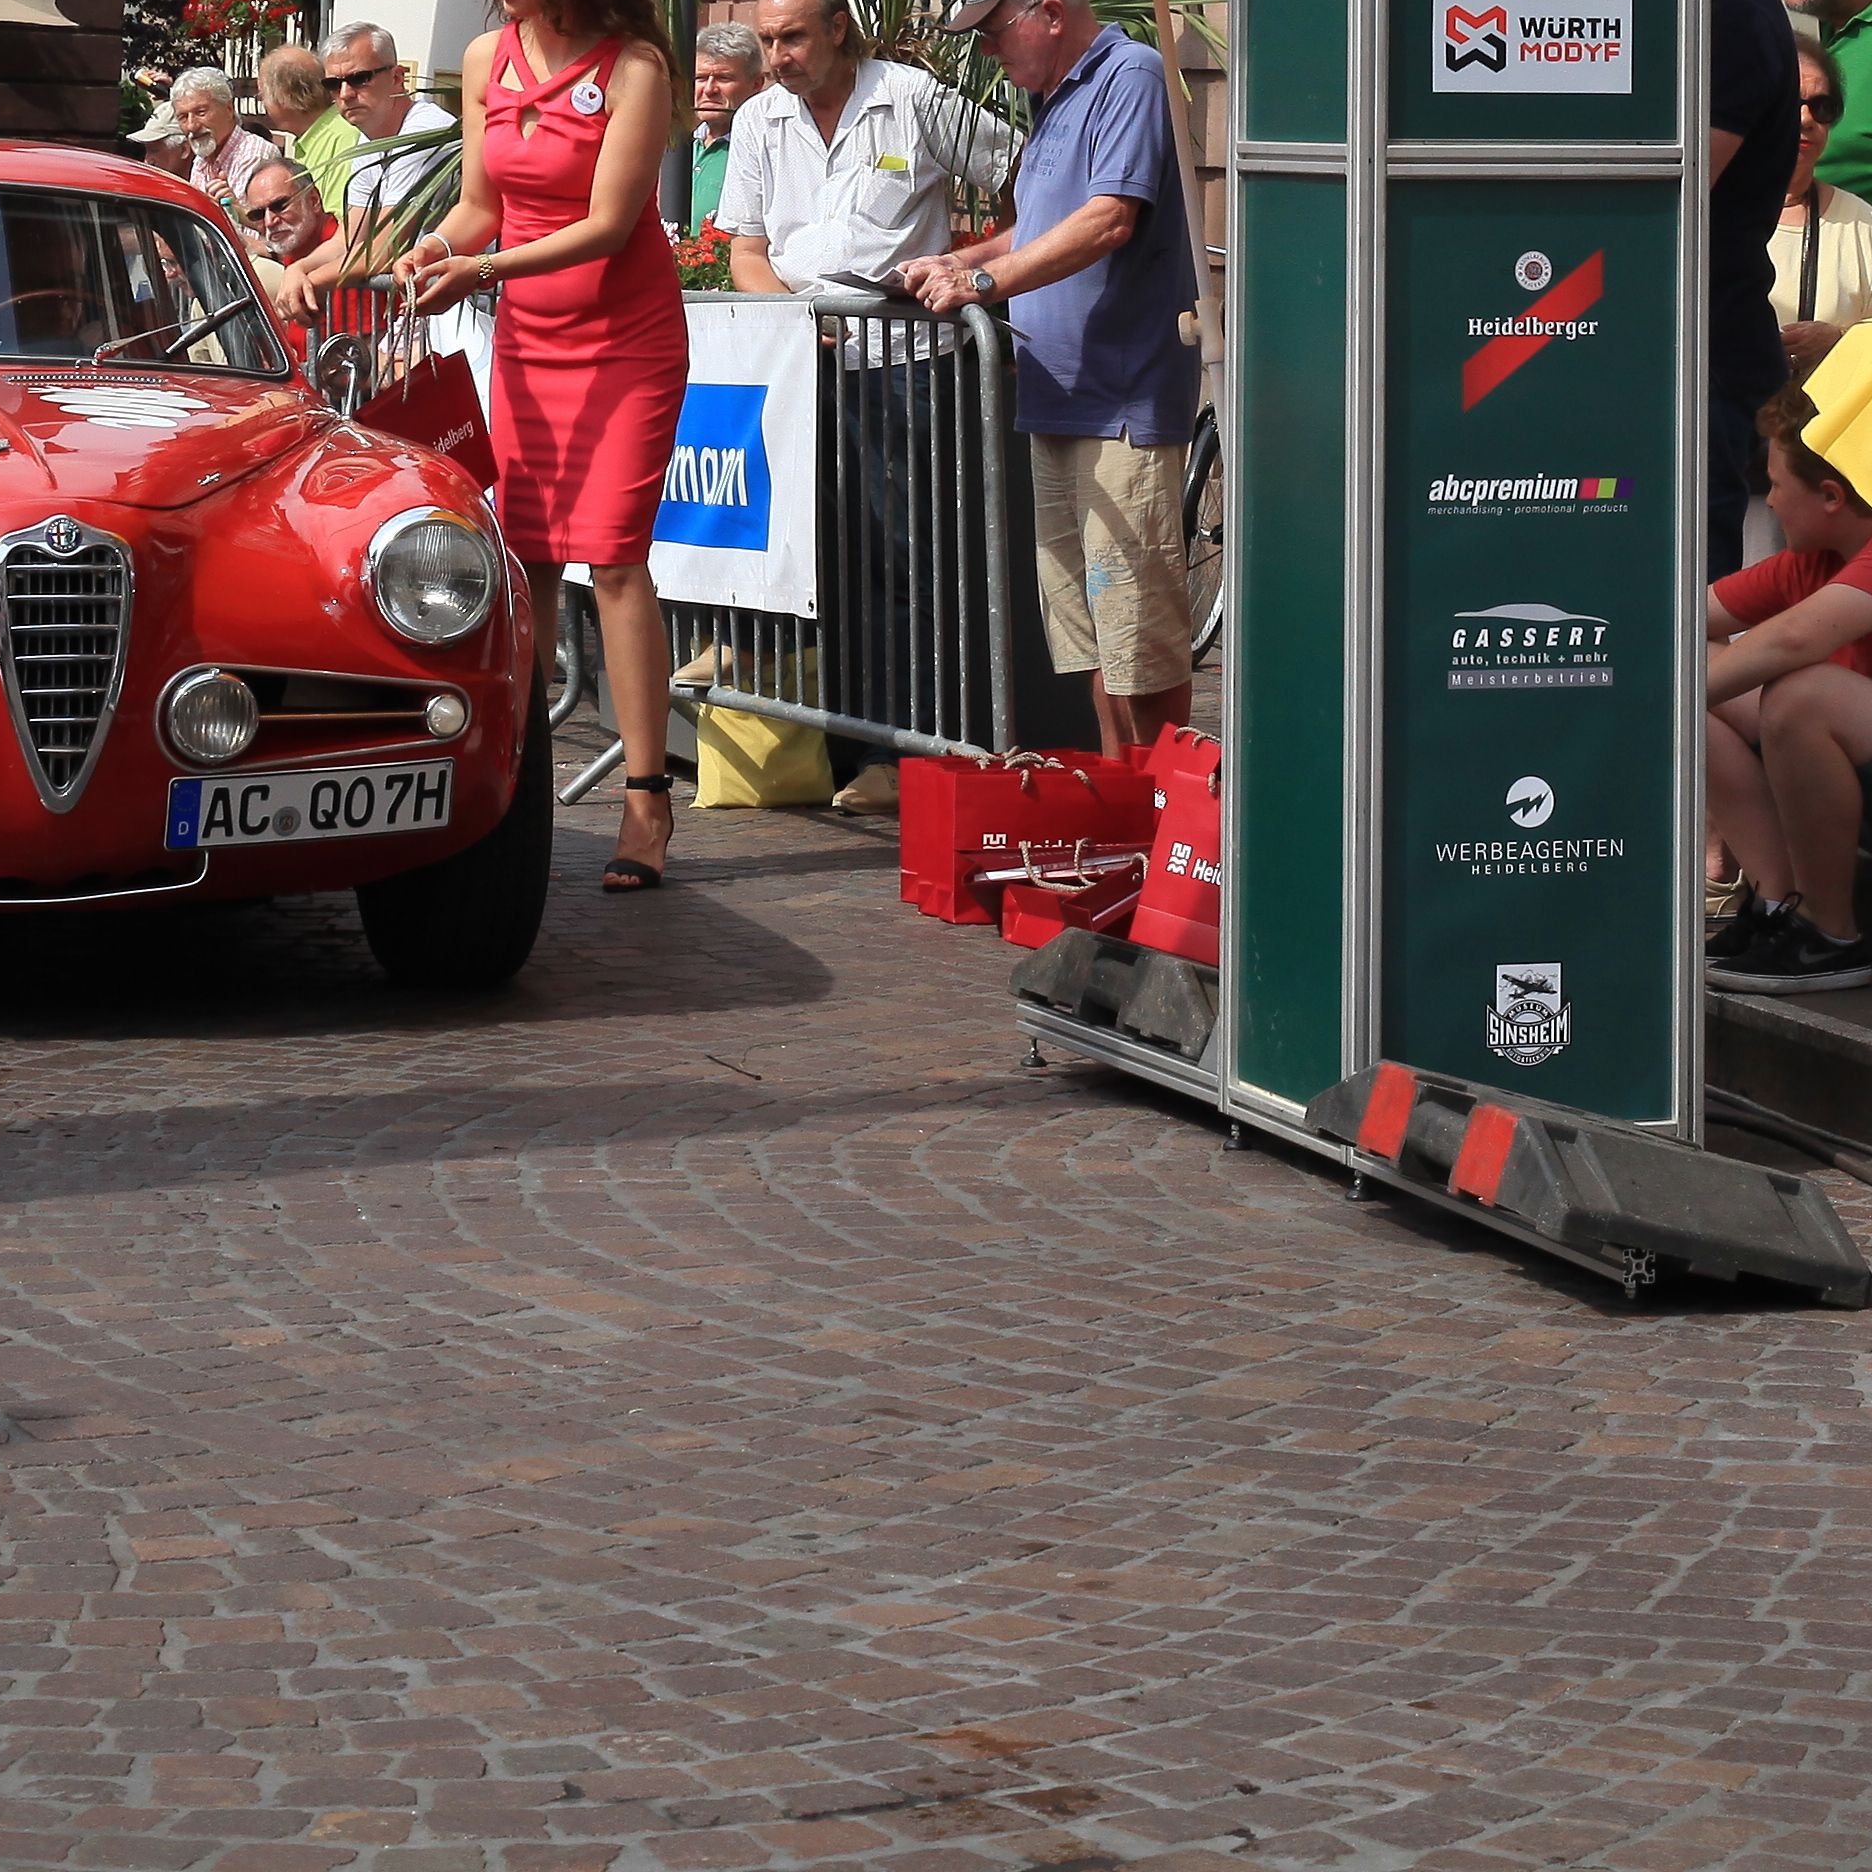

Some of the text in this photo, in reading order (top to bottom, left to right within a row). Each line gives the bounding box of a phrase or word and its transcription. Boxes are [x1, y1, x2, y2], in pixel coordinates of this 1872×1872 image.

[1519, 16, 1621, 40] WÜRTH
[1519, 41, 1621, 63] MODYF
[1468, 317, 1599, 341] Heidelberger
[1428, 472, 1579, 507] abcpremium
[1427, 503, 1629, 516] merchandising promotional products
[1451, 626, 1607, 649] GASSERT
[1451, 654, 1490, 667] auto,
[1495, 652, 1551, 665] technik
[1573, 651, 1608, 663] mehr
[1451, 672, 1609, 686] Meisterbetrieb
[202, 784, 270, 839] AC
[178, 821, 189, 836] D
[1436, 838, 1625, 862] WERBEAGENTEN
[1471, 861, 1588, 876] HEIDELBERG
[1507, 1001, 1550, 1018] MUSEUM
[1489, 1008, 1569, 1045] SINSHEIM
